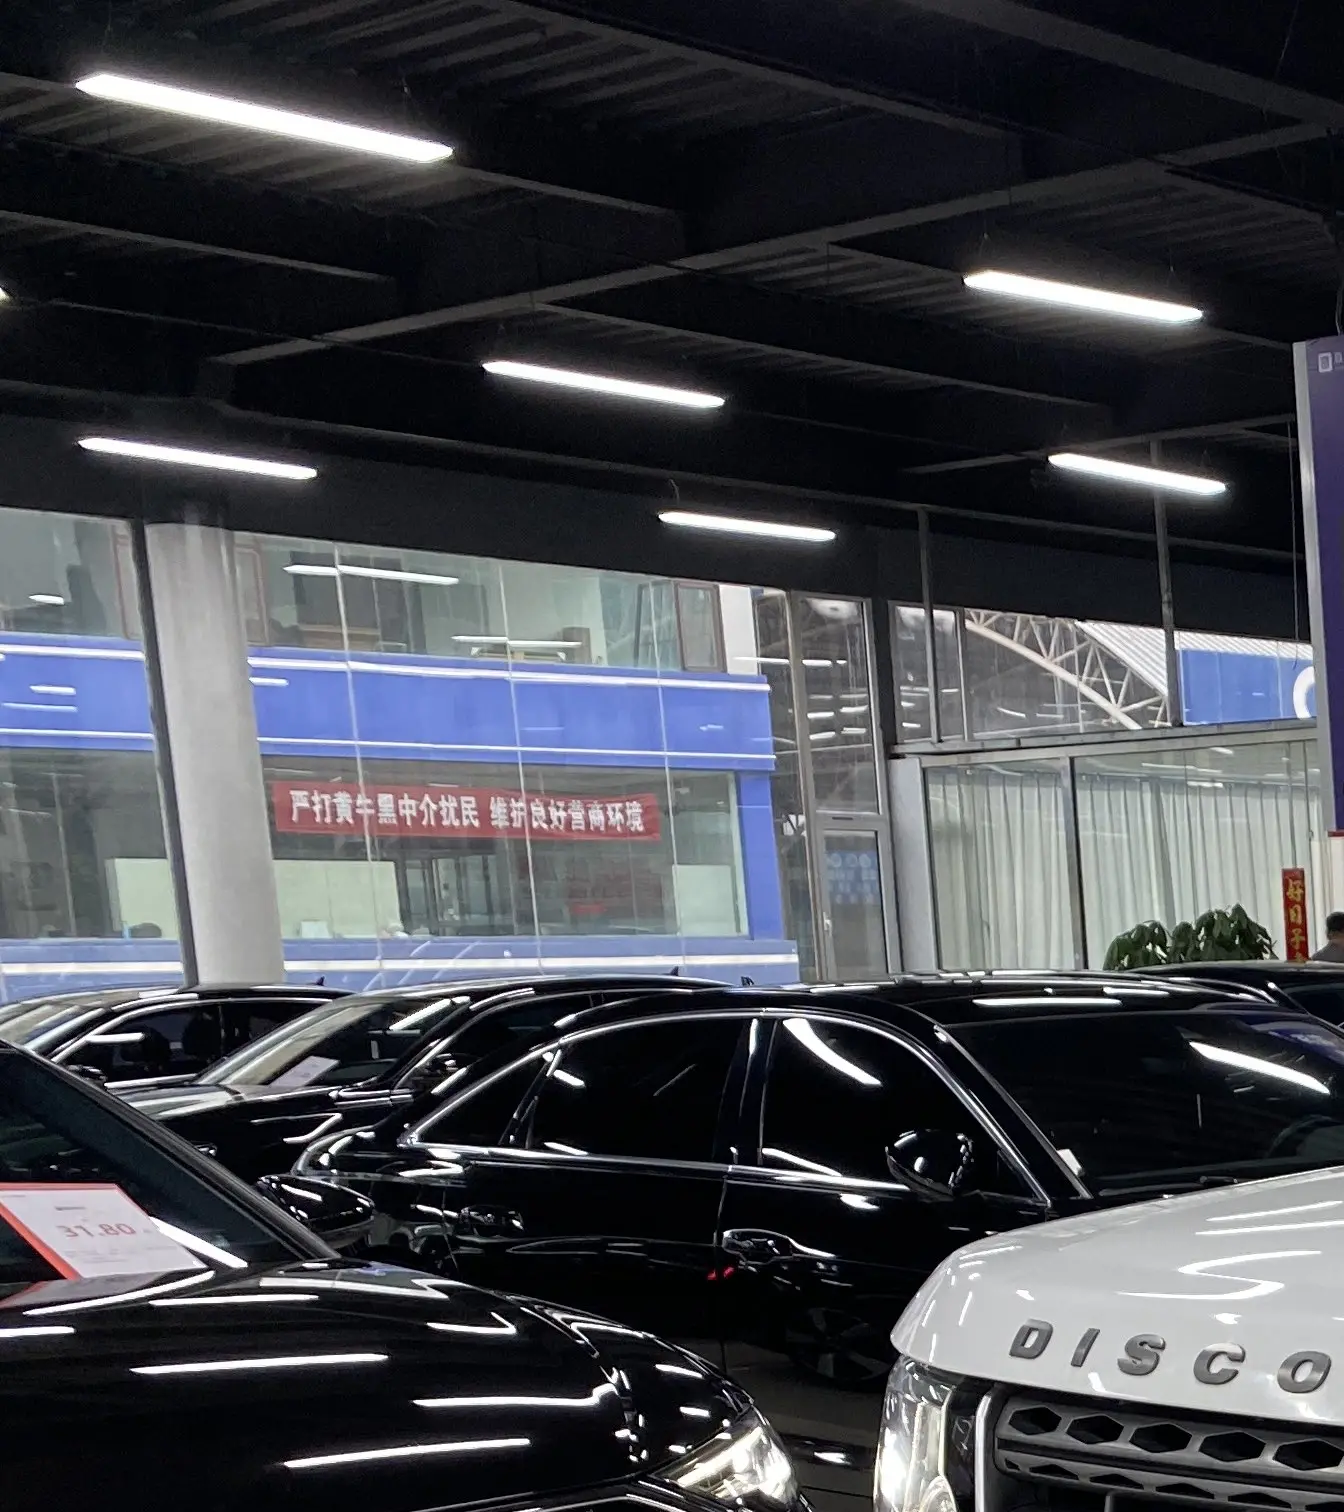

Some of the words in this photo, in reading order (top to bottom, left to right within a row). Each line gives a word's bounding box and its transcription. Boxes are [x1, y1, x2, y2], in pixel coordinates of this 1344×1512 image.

[289, 789, 480, 829] 严打黄牛黑中介扰民
[489, 795, 645, 834] 维护良好营商环境
